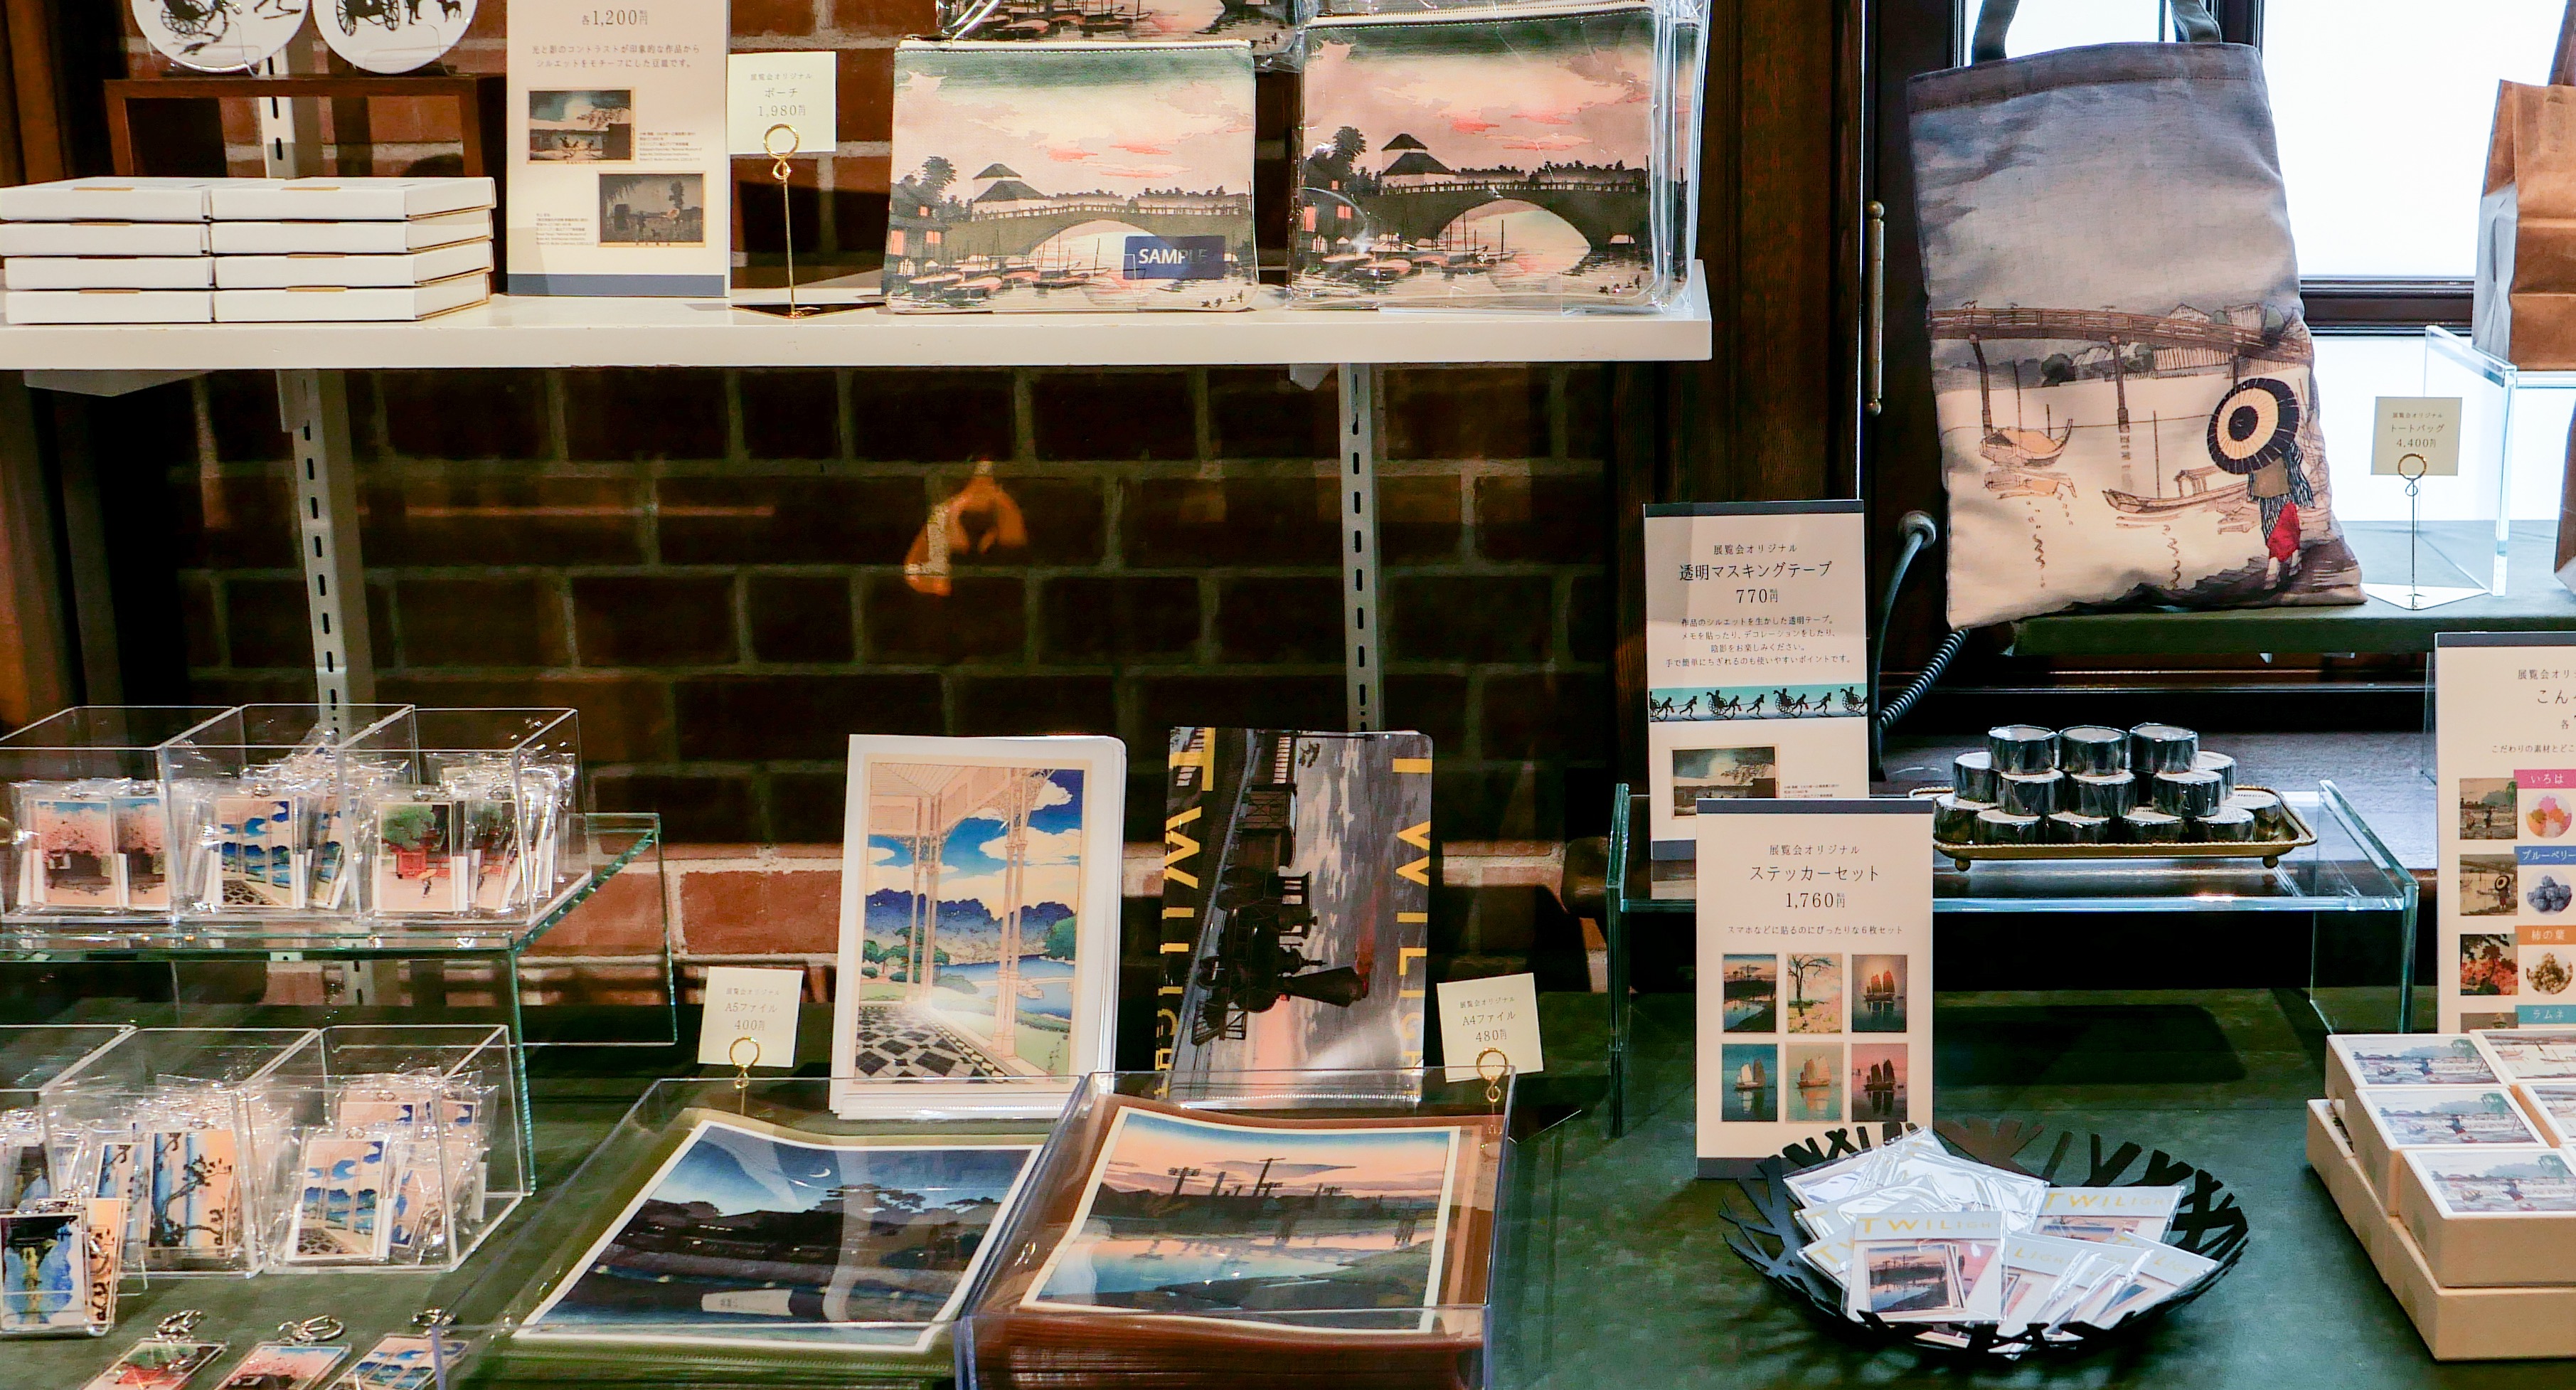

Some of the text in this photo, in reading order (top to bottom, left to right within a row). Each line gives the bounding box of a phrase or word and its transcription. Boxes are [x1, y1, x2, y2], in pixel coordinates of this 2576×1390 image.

[765, 87, 798, 98] ポーチ
[1138, 248, 1208, 265] SAMPLE
[2391, 423, 2445, 433] トートバッグ
[1713, 543, 1797, 556] 展覧会オリジナル
[1679, 561, 1833, 581] 透明マスキングテープ
[2518, 669, 2576, 679] 展覧会オリ
[2538, 689, 2576, 704] こん
[2530, 773, 2564, 785] いろは
[1769, 844, 1860, 856] 展覧会オリジナル
[2522, 849, 2576, 861] ブルーベリー
[1750, 865, 1878, 882] ステッカーセット
[725, 1002, 778, 1013] A5ファイル
[1462, 1011, 1516, 1026] A4ファイル
[2533, 1009, 2564, 1019] ラムネ
[1858, 1217, 1991, 1234] TWILIGH
